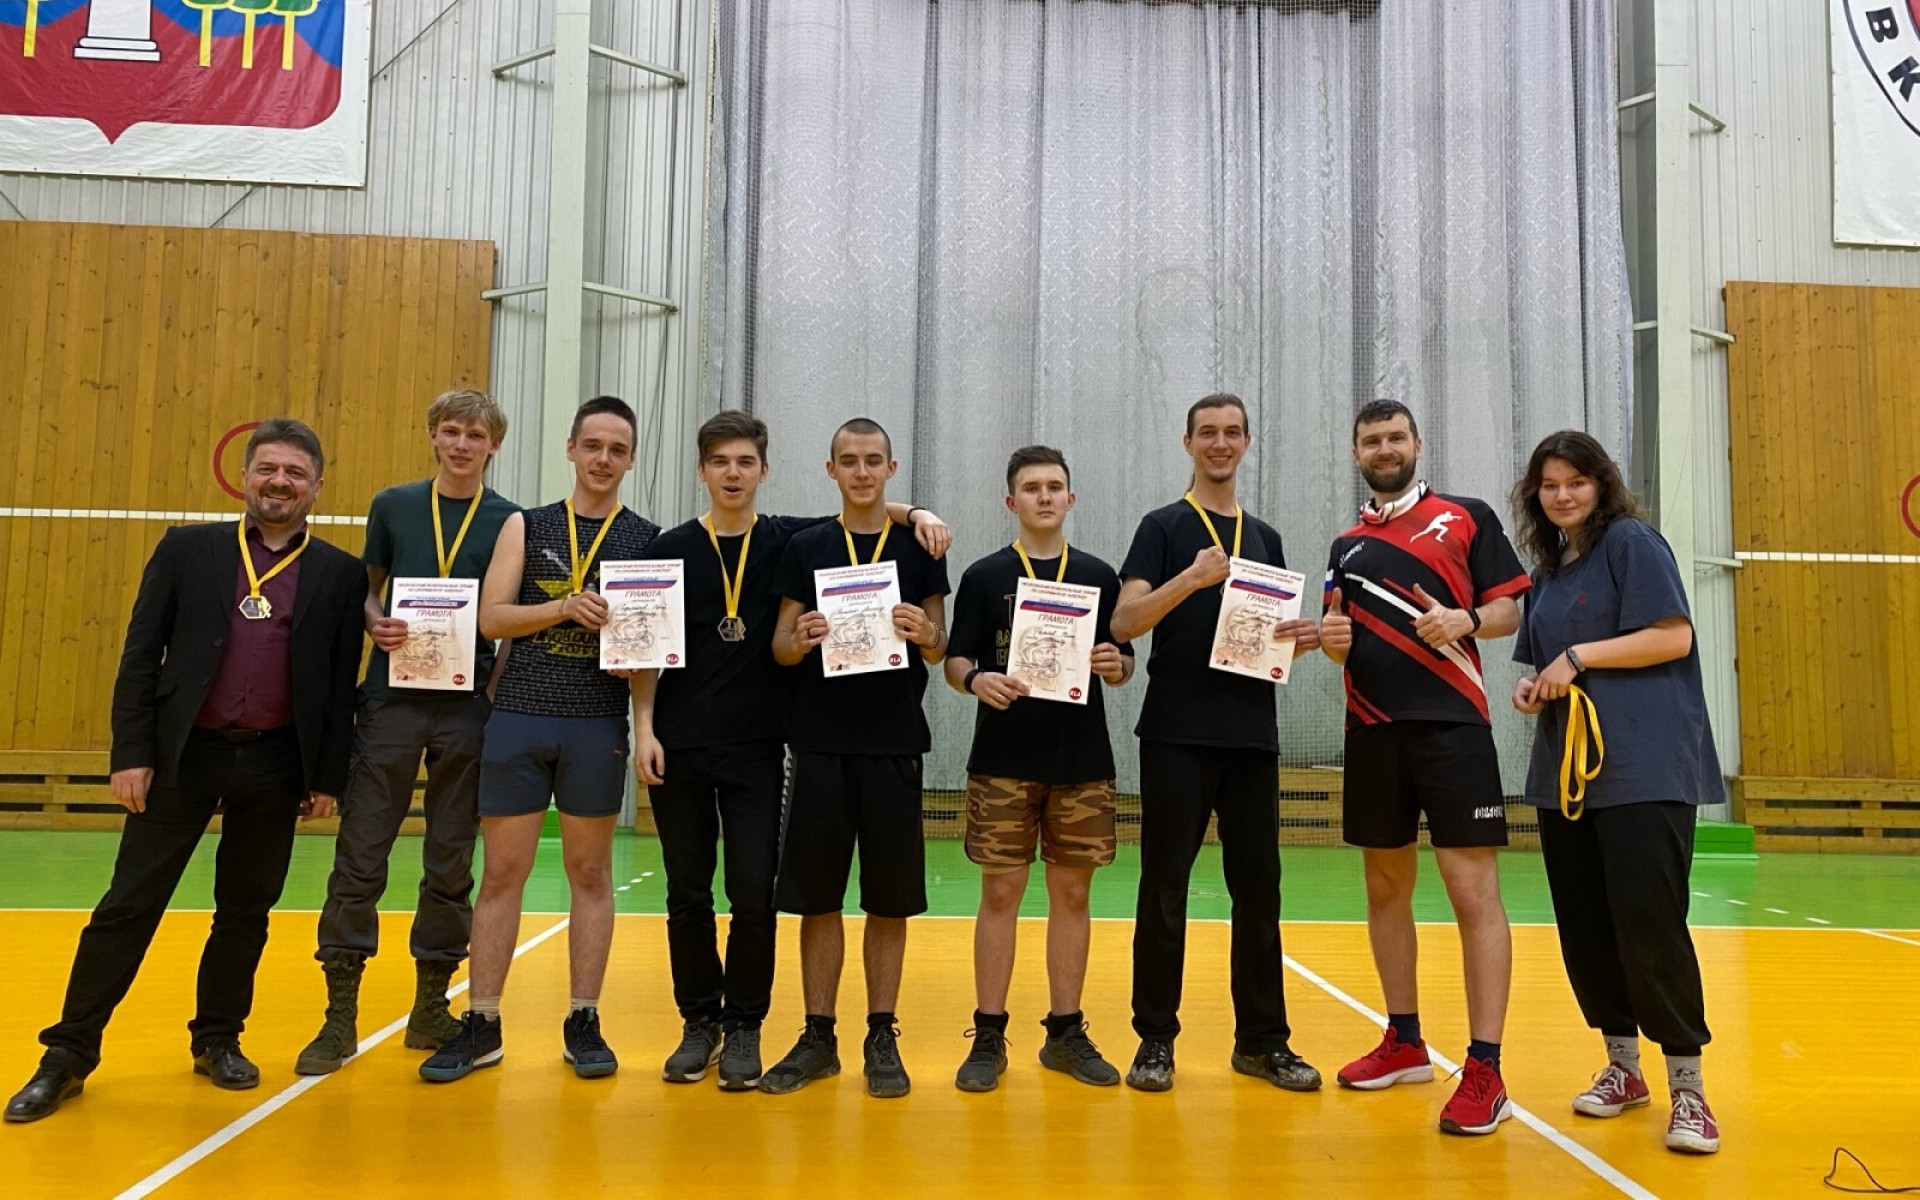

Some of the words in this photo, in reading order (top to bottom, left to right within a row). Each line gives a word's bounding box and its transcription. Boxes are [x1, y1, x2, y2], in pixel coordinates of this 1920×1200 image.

[624, 590, 662, 598] ГРАМОТА
[841, 592, 878, 602] ГРАМОТА
[1246, 593, 1281, 607] ГРАМОТА
[416, 610, 452, 618] ГРАМОТА
[1037, 613, 1074, 625] ГРАМОТА
